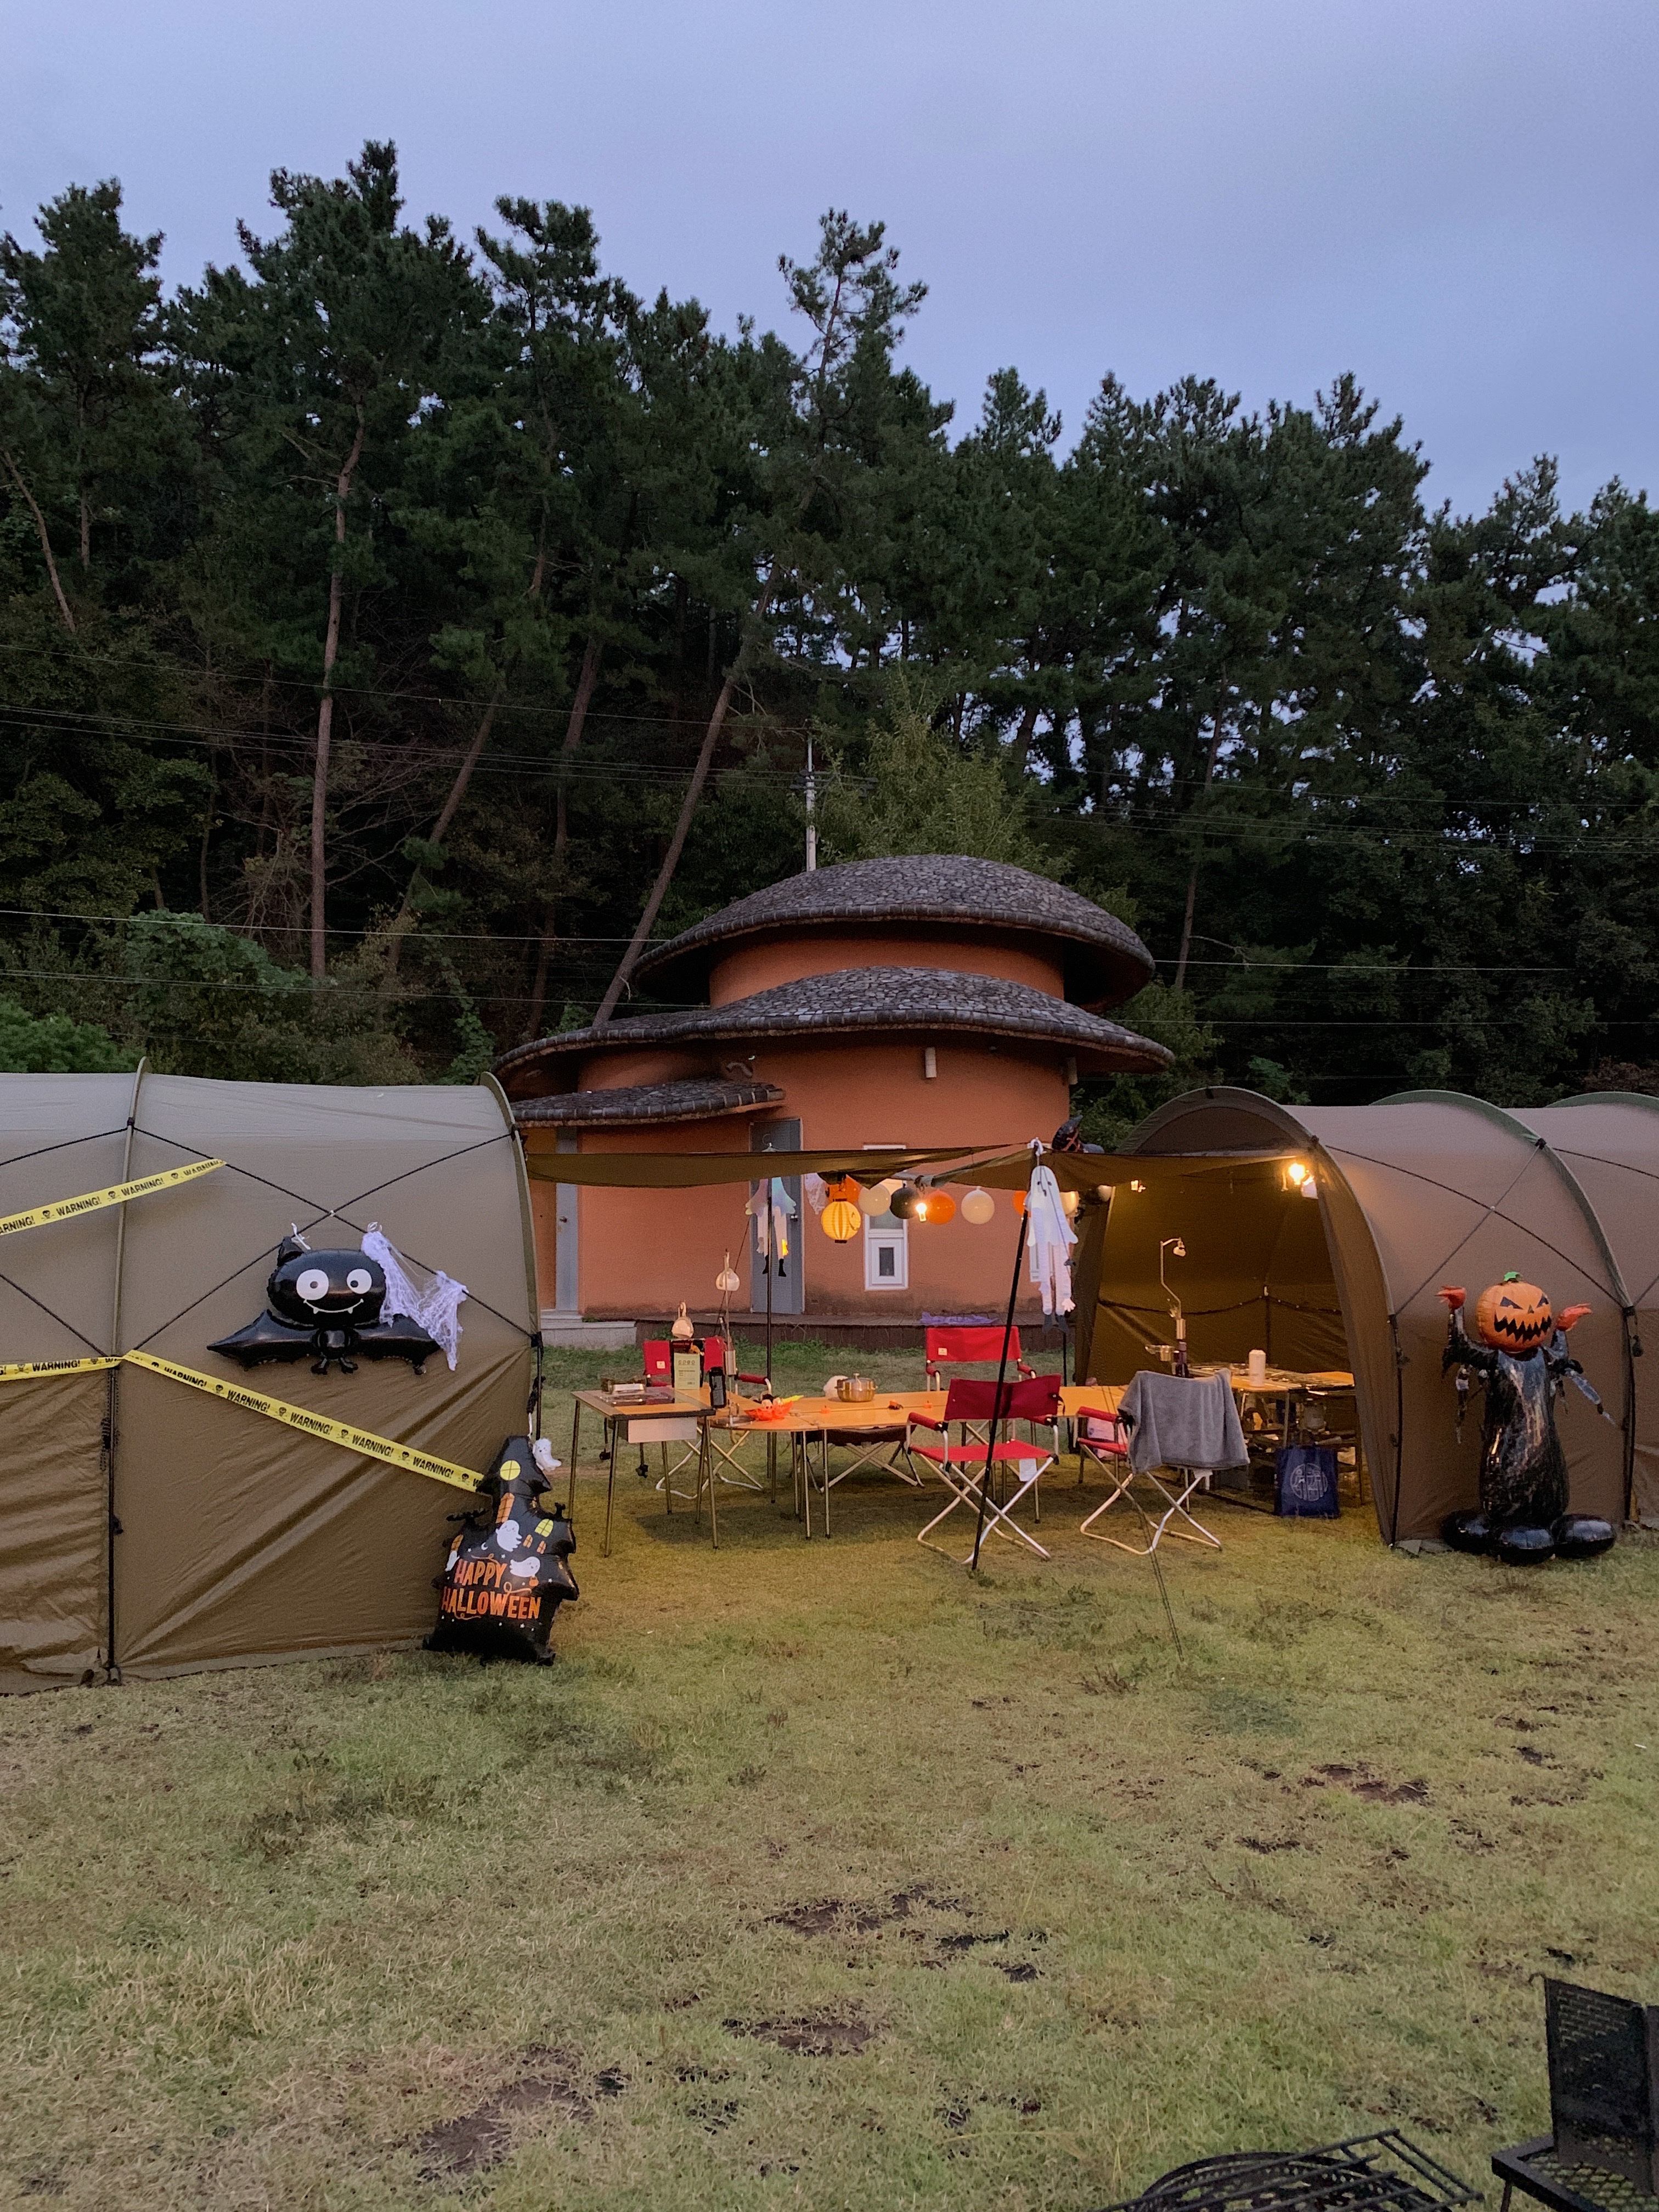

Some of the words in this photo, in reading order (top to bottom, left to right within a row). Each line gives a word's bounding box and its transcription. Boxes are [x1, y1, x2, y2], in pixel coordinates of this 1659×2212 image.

[56, 1196, 102, 1217] WARNING!
[121, 1177, 165, 1196] WARNING!
[32, 1359, 80, 1372] WARNING!
[227, 1389, 270, 1413] WARNING!
[290, 1412, 333, 1435] WARNING!
[352, 1434, 394, 1457] WARNING!
[413, 1457, 454, 1479] WARNING!
[454, 1558, 508, 1588] HAPPY
[441, 1585, 541, 1619] HALLOWEEN
